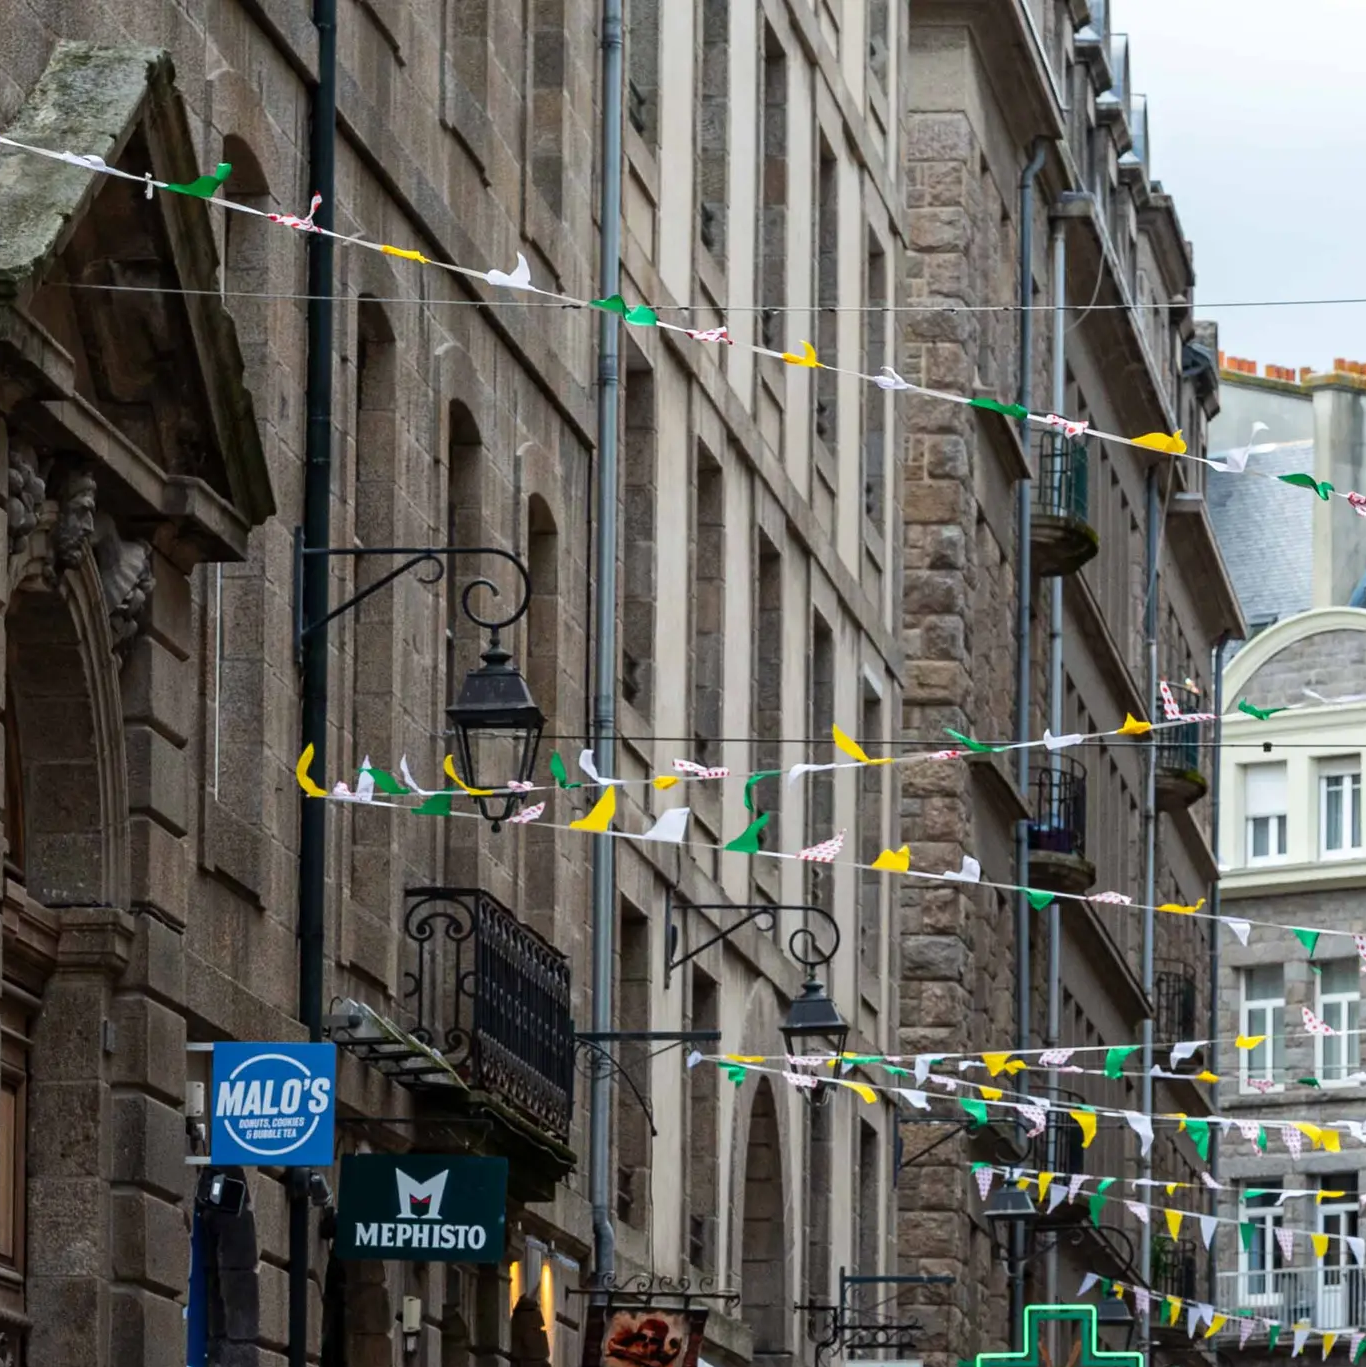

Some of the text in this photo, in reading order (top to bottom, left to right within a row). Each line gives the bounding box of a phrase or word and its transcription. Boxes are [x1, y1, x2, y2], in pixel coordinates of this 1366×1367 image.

[215, 1077, 331, 1117] MALO'S
[272, 1116, 305, 1128] COOKIES
[253, 1128, 282, 1139] BUBBLE
[282, 1128, 297, 1138] TEA
[354, 1221, 487, 1250] MEPHISTO
